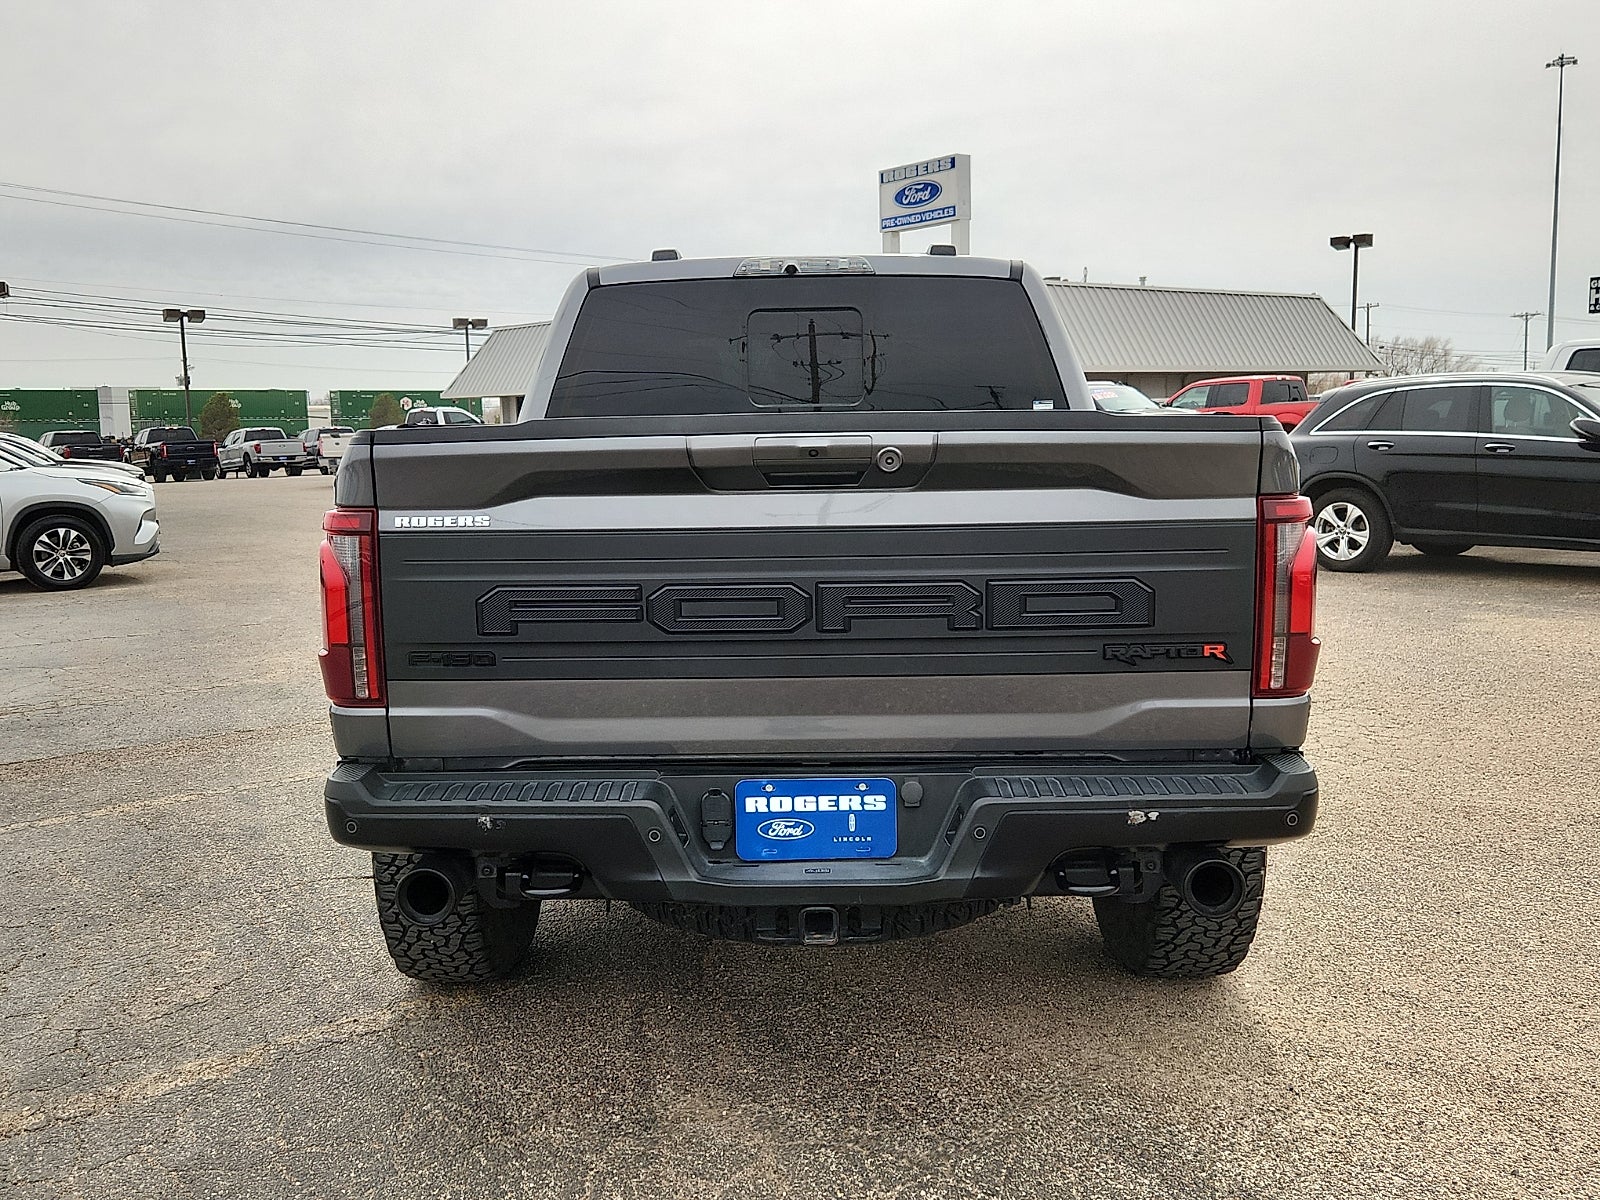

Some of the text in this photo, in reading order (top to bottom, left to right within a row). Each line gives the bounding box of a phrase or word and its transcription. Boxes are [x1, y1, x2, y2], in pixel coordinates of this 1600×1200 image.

[883, 158, 952, 183] ROGERS
[902, 184, 931, 205] Ford
[882, 208, 954, 228] PRE-OWNED VEHICLES
[394, 515, 491, 528] ROGERS
[477, 578, 1155, 636] FORD
[408, 651, 497, 667] F-150
[1103, 642, 1234, 666] RAPTOR
[745, 795, 887, 813] ROGERS
[768, 821, 804, 837] Ford
